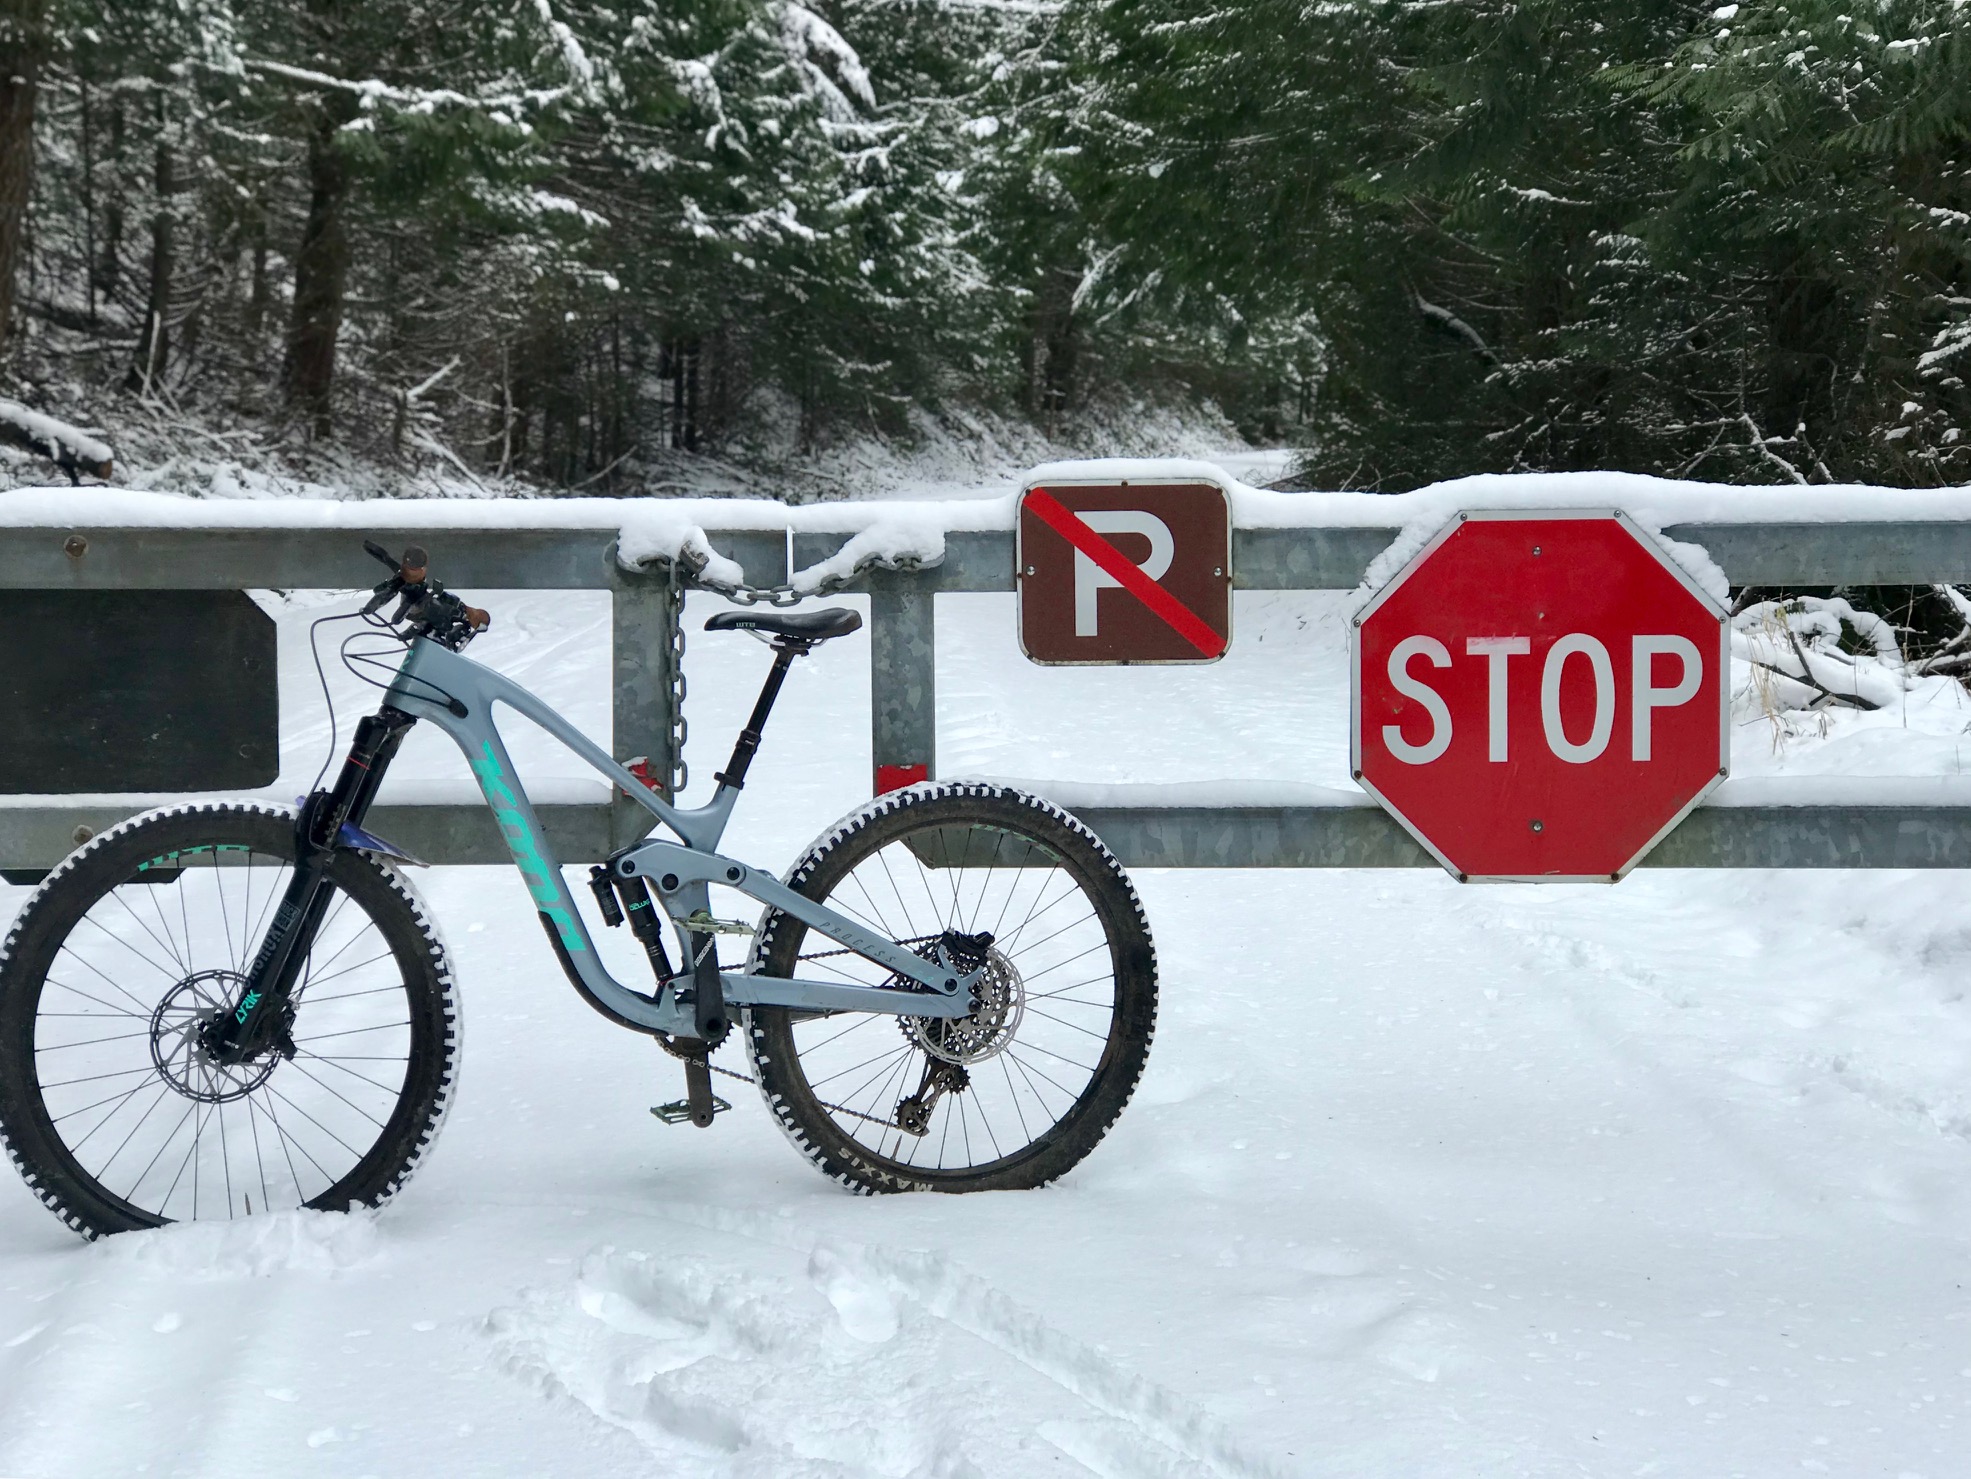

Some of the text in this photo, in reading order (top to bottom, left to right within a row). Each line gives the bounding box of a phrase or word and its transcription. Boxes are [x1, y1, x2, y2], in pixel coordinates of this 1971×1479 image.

[1073, 510, 1175, 637] P
[1382, 633, 1703, 765] STOP
[819, 921, 897, 963] PROCESS
[235, 989, 263, 1025] LYRIK
[837, 1147, 934, 1192] MAXXIS
